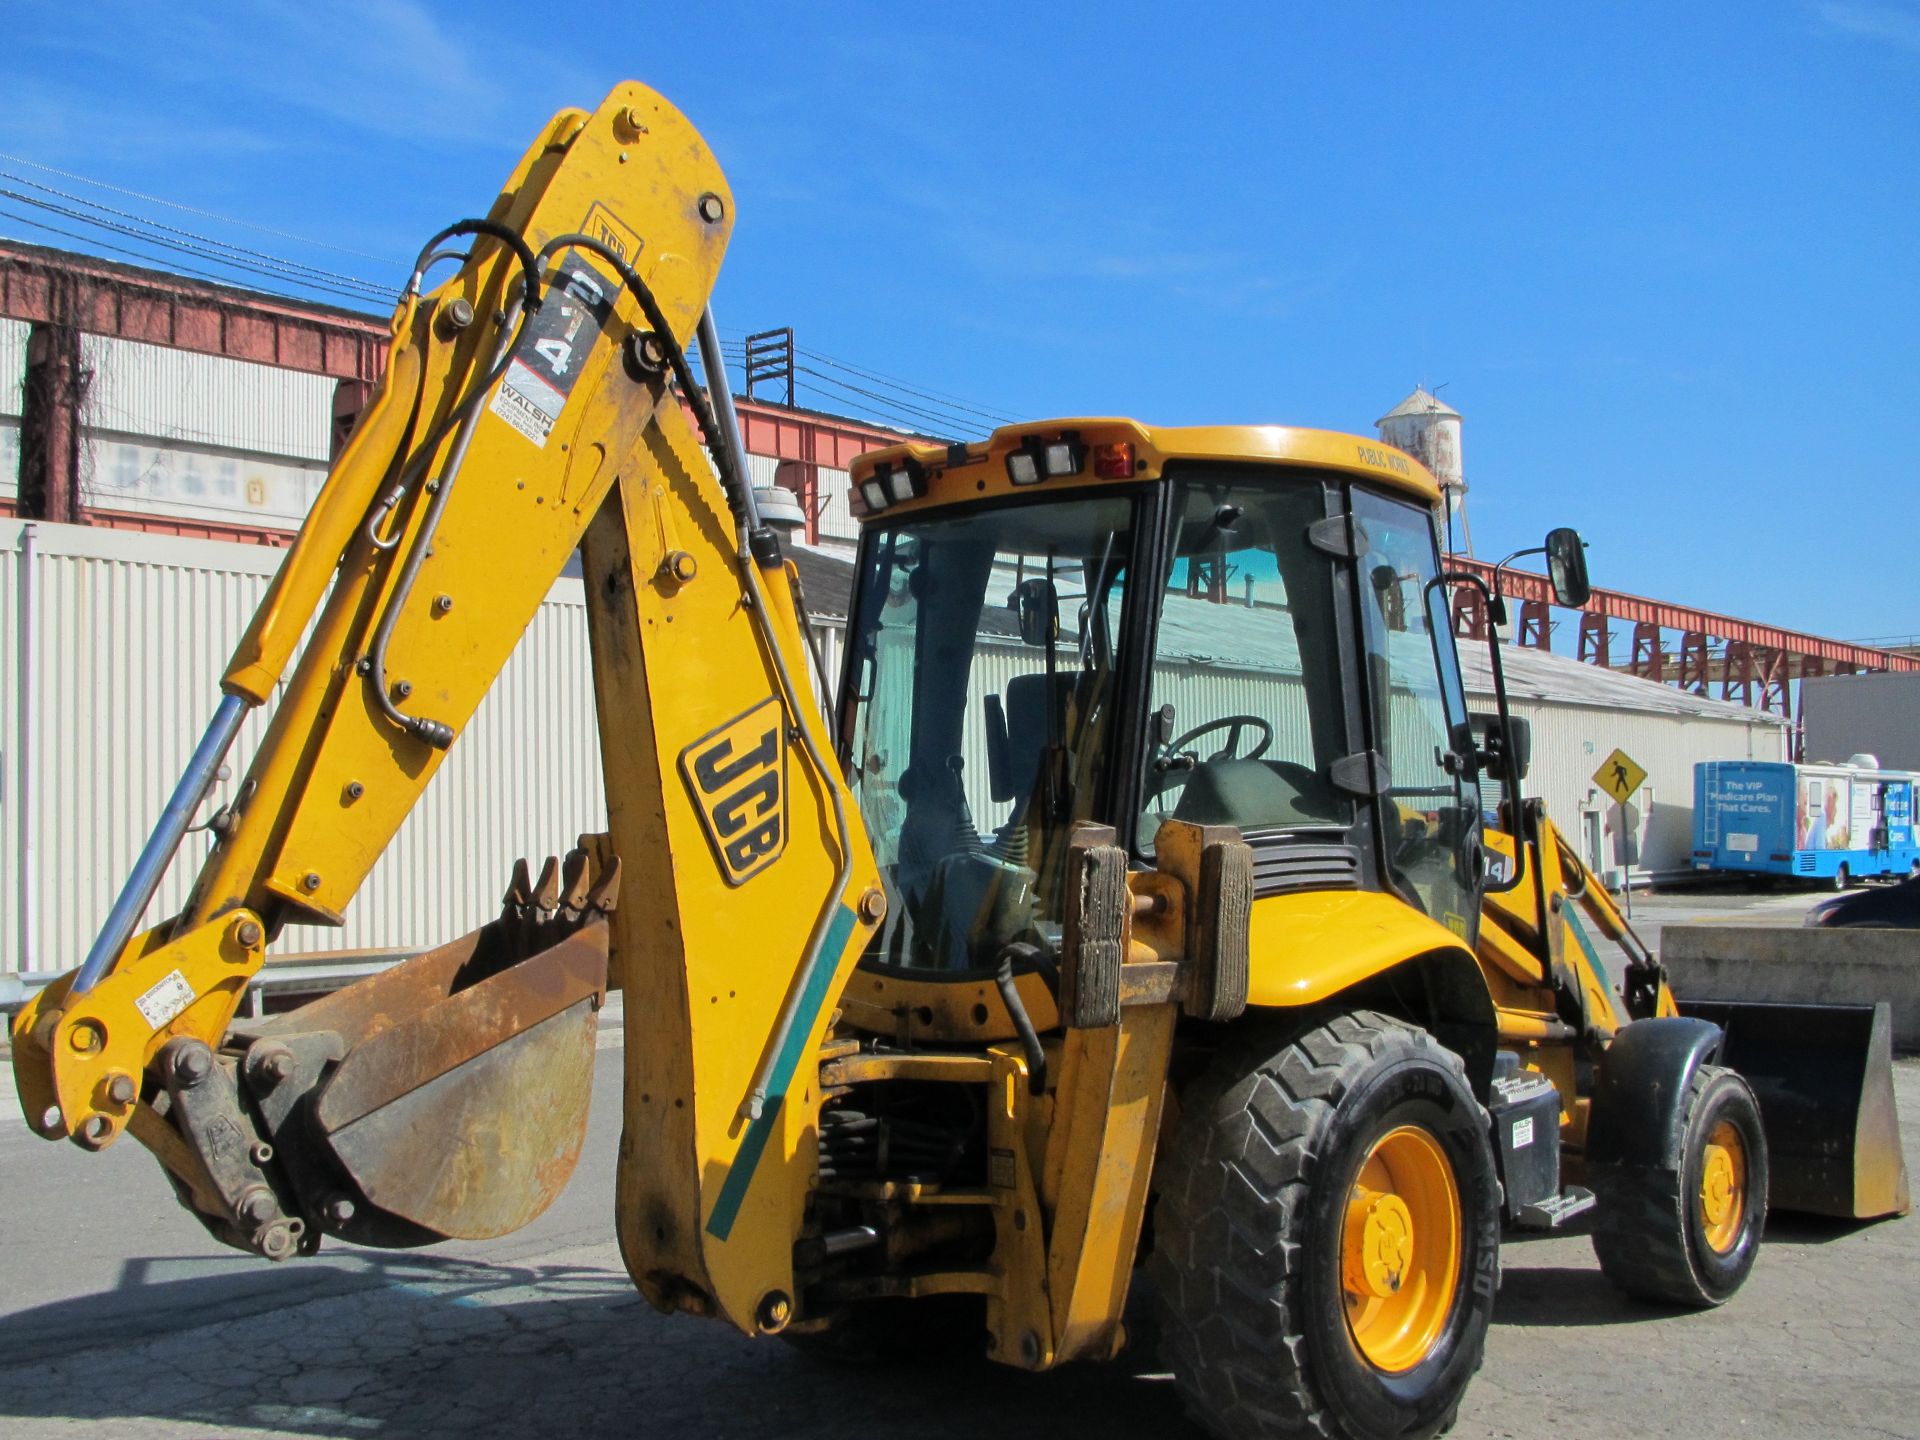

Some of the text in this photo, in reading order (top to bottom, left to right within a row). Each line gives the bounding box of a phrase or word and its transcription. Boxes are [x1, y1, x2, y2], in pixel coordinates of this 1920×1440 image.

[501, 384, 553, 428] WALSH
[1357, 446, 1410, 476] PUBLIC WORKS
[1726, 781, 1763, 791] The VIP
[695, 727, 779, 871] JCB
[1710, 792, 1778, 802] Medicare Plan
[1718, 803, 1739, 812] That
